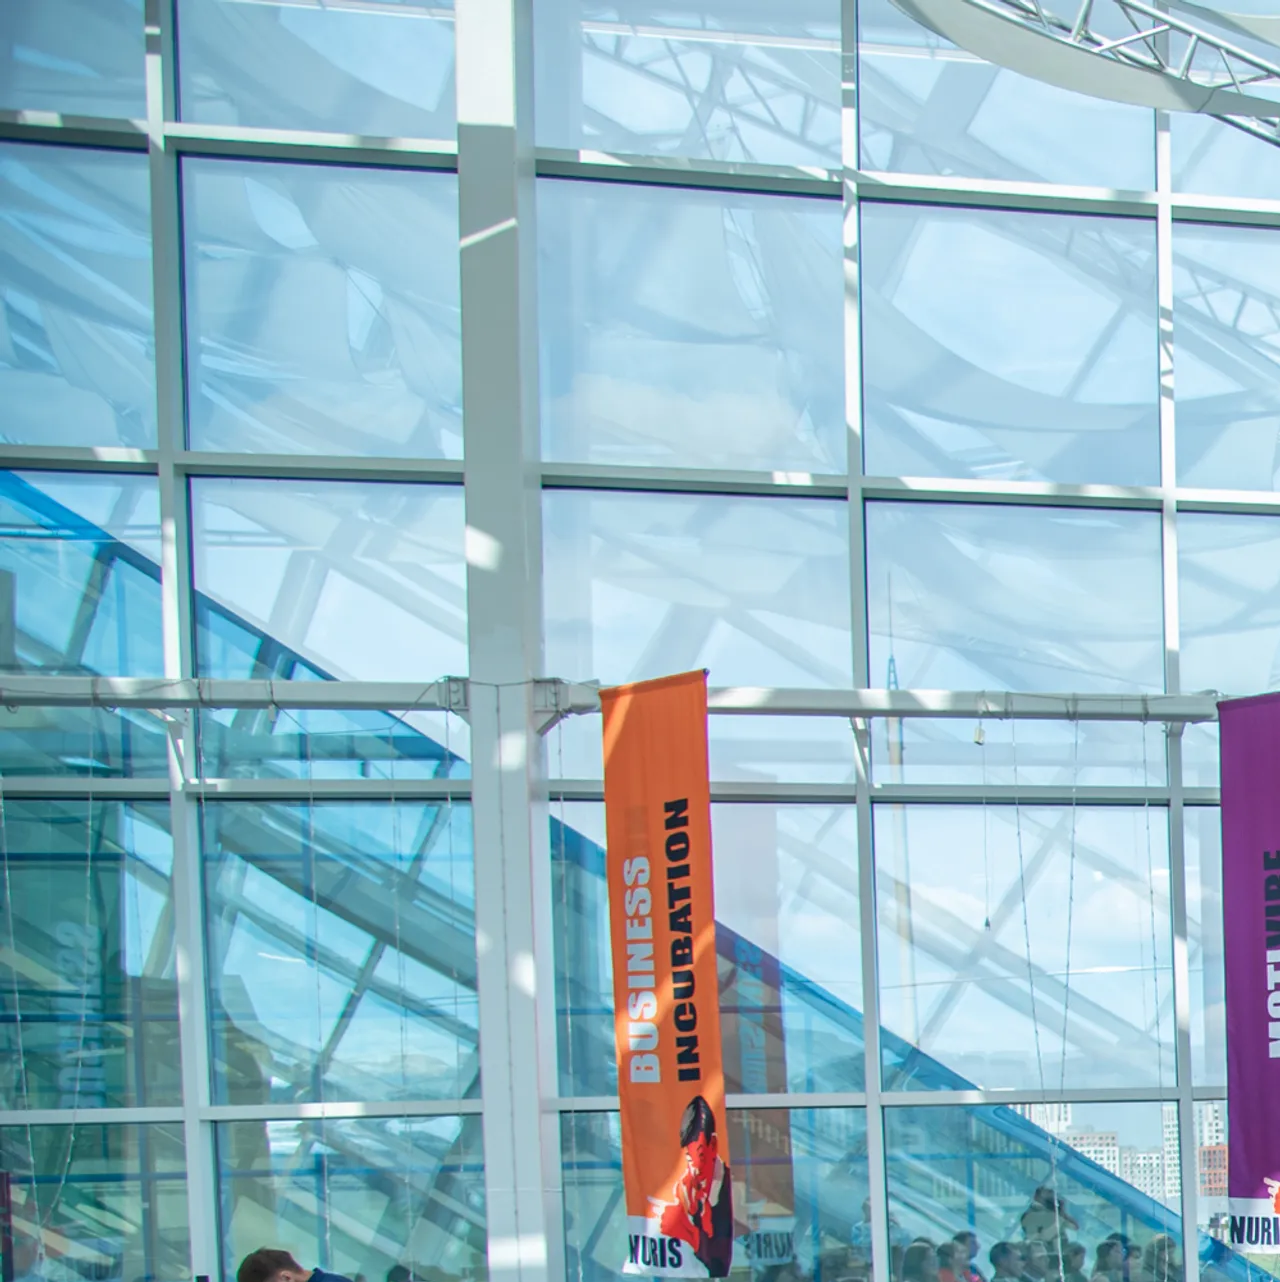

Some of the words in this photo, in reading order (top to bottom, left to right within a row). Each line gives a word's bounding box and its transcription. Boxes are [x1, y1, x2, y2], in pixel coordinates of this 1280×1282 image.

[623, 855, 661, 1085] BUSINESS
[664, 798, 701, 1083] INCUBATION
[628, 1234, 683, 1269] NURIS
